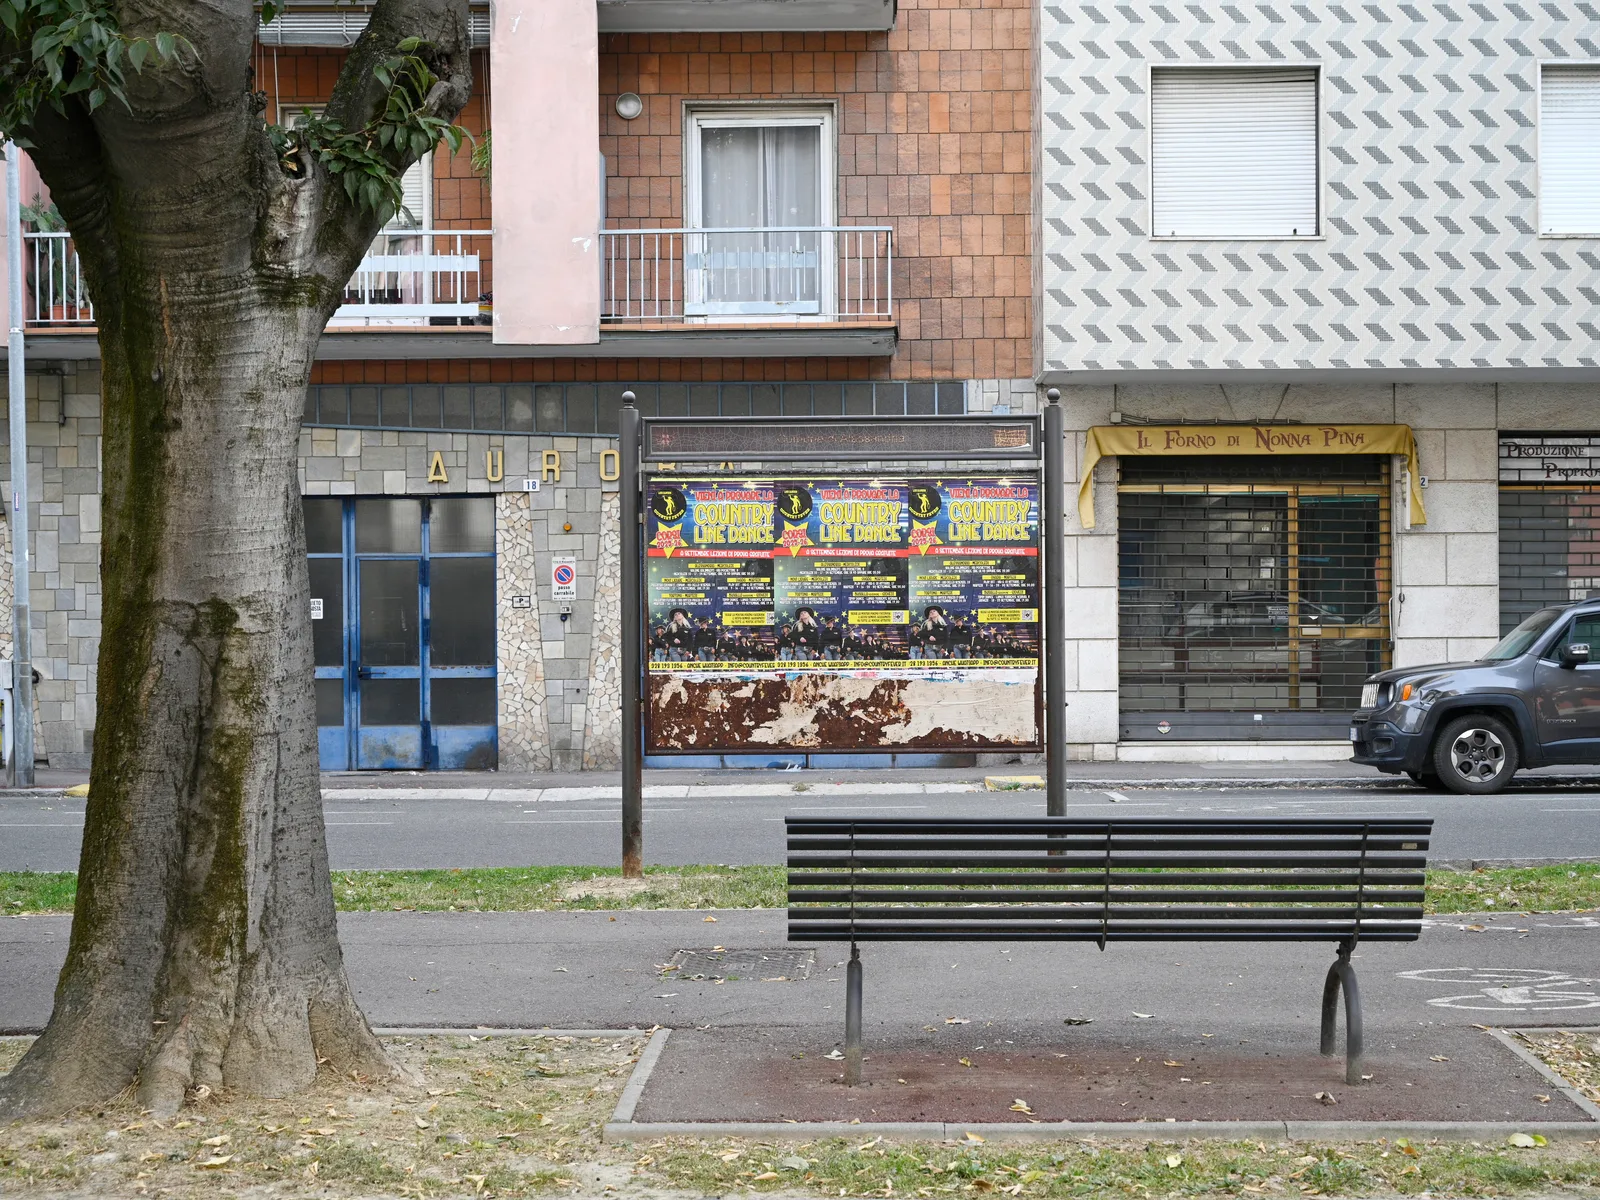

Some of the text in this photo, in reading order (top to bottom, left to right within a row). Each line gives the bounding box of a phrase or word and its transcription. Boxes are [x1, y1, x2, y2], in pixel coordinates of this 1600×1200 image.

[1136, 426, 1364, 452] IL FORNO DI NONNA PINA
[1502, 442, 1585, 457] PRODUZIONE
[527, 480, 536, 490] 18
[1420, 477, 1426, 486] 2
[695, 490, 774, 501] VIENI A PROVARE LA
[821, 489, 842, 500] VIENI
[843, 489, 850, 500] A
[851, 489, 887, 500] PROVARE
[888, 489, 900, 500] LA
[949, 487, 1028, 499] VIENI A PROVARE LA
[694, 502, 774, 525] COUNTRY
[820, 502, 901, 524] COUNTRY
[949, 500, 1030, 523] COUNTRY
[656, 530, 681, 541] CORSI
[694, 526, 774, 544] LINE DANCE
[782, 529, 806, 540] CORSI
[820, 524, 901, 542] LINE DANCE
[911, 527, 936, 538] CORSI
[949, 523, 1030, 541] LINE DANCE
